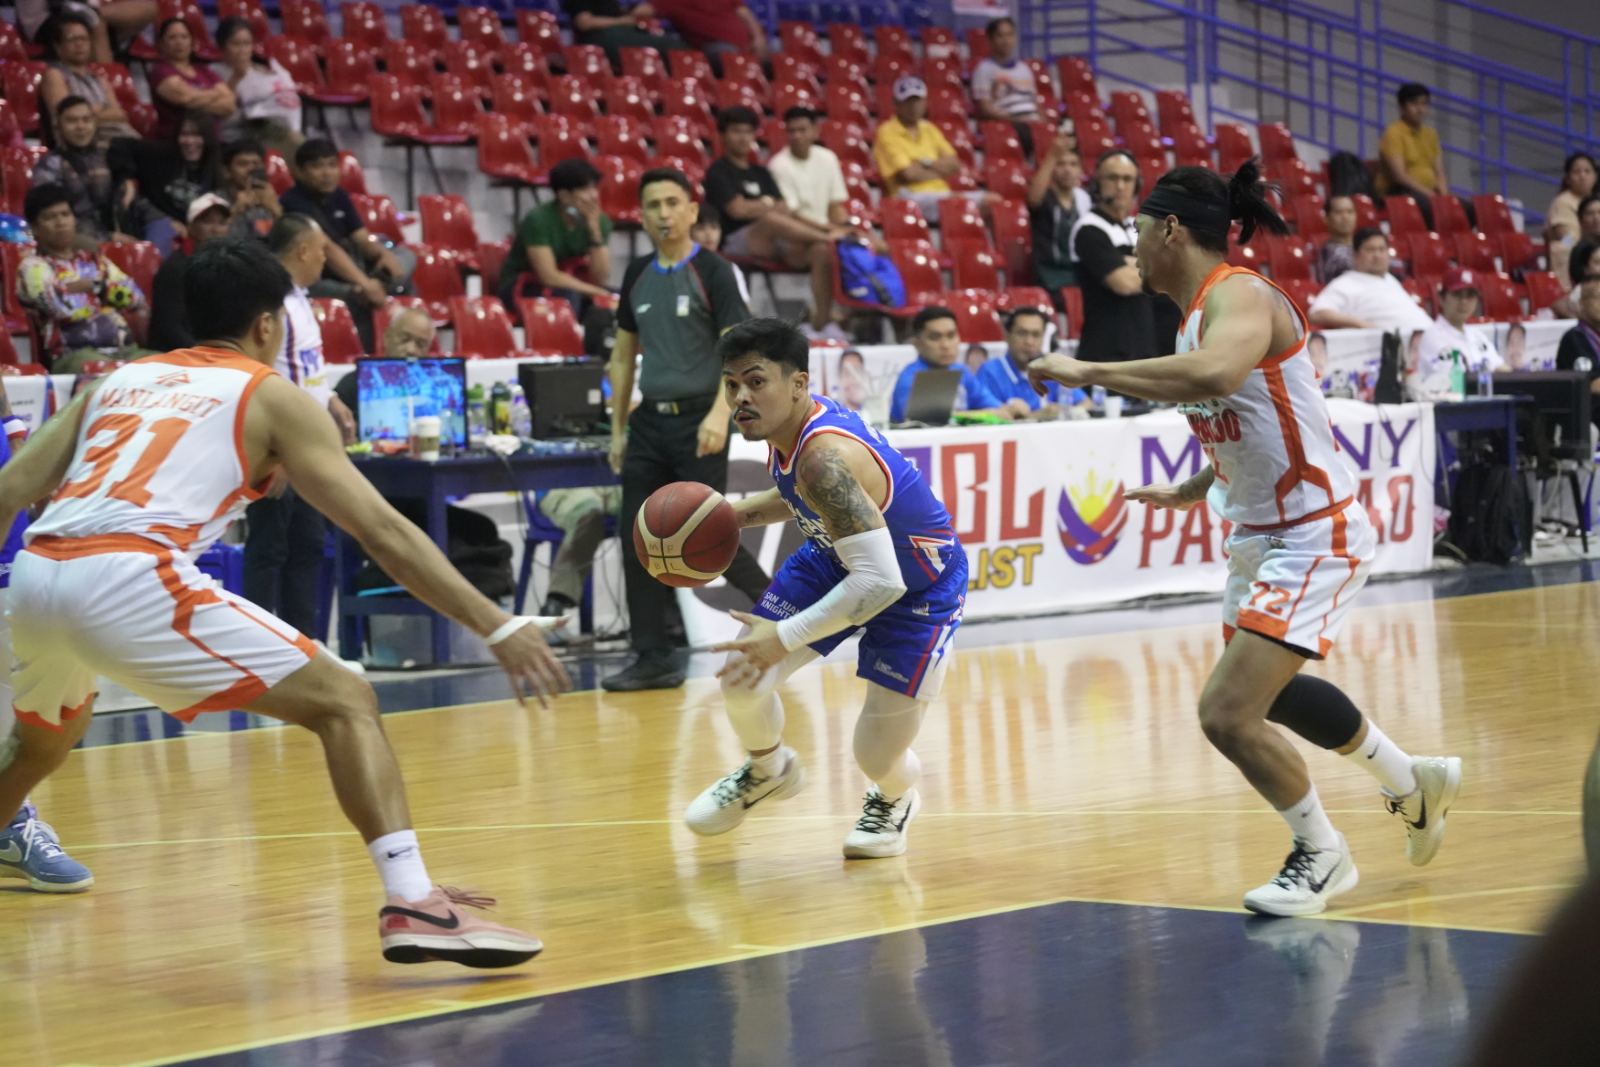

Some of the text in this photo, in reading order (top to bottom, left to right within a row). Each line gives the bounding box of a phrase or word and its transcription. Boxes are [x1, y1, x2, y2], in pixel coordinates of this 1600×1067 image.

[51, 413, 192, 508] 31
[968, 544, 1043, 592] IST
[761, 600, 792, 619] KNIGHT
[764, 591, 779, 603] SAN
